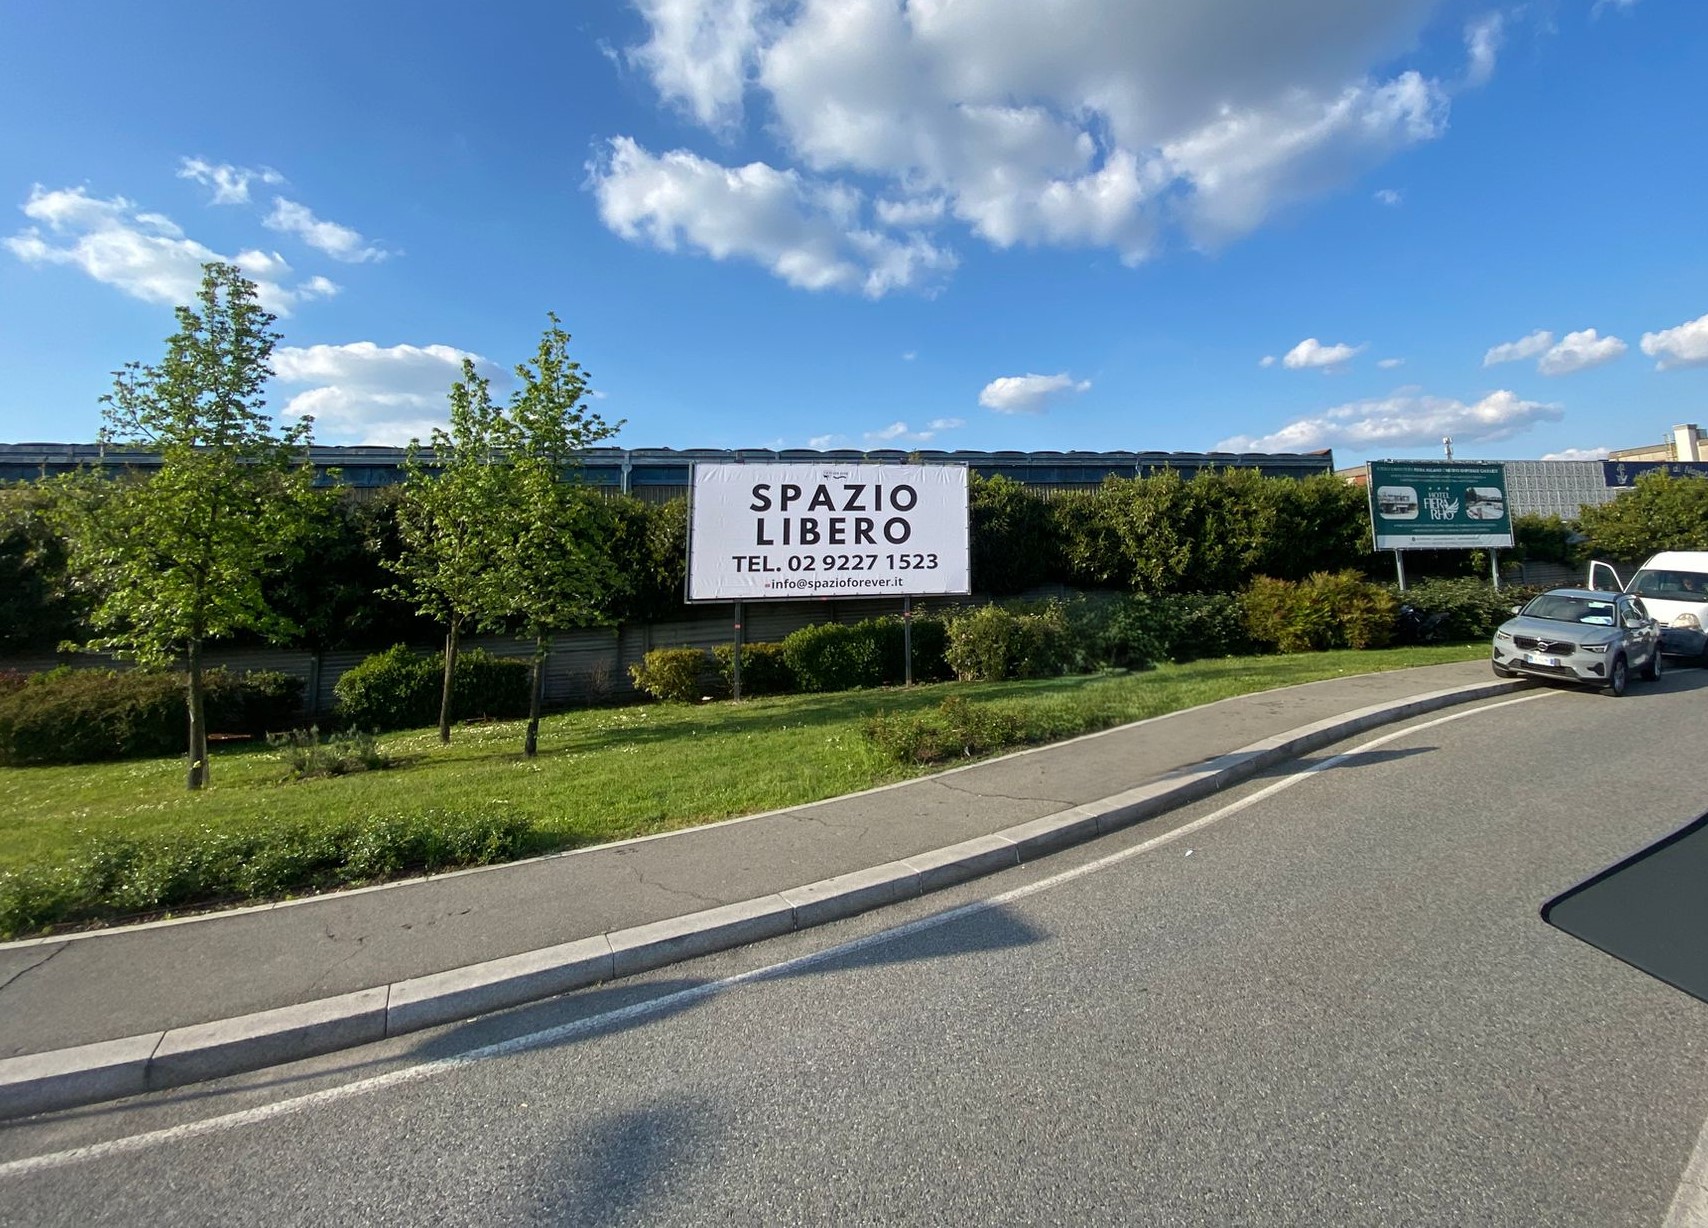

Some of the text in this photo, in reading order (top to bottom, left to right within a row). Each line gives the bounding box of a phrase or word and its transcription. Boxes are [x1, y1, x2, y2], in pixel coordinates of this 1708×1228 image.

[750, 484, 918, 512] SPAZIO
[1423, 498, 1449, 509] FIERA
[1430, 509, 1455, 520] RHO
[757, 517, 911, 546] LIBERO
[732, 553, 938, 573] TEL. 02 9227 1523
[771, 576, 903, 591] info@spazioforever.it
